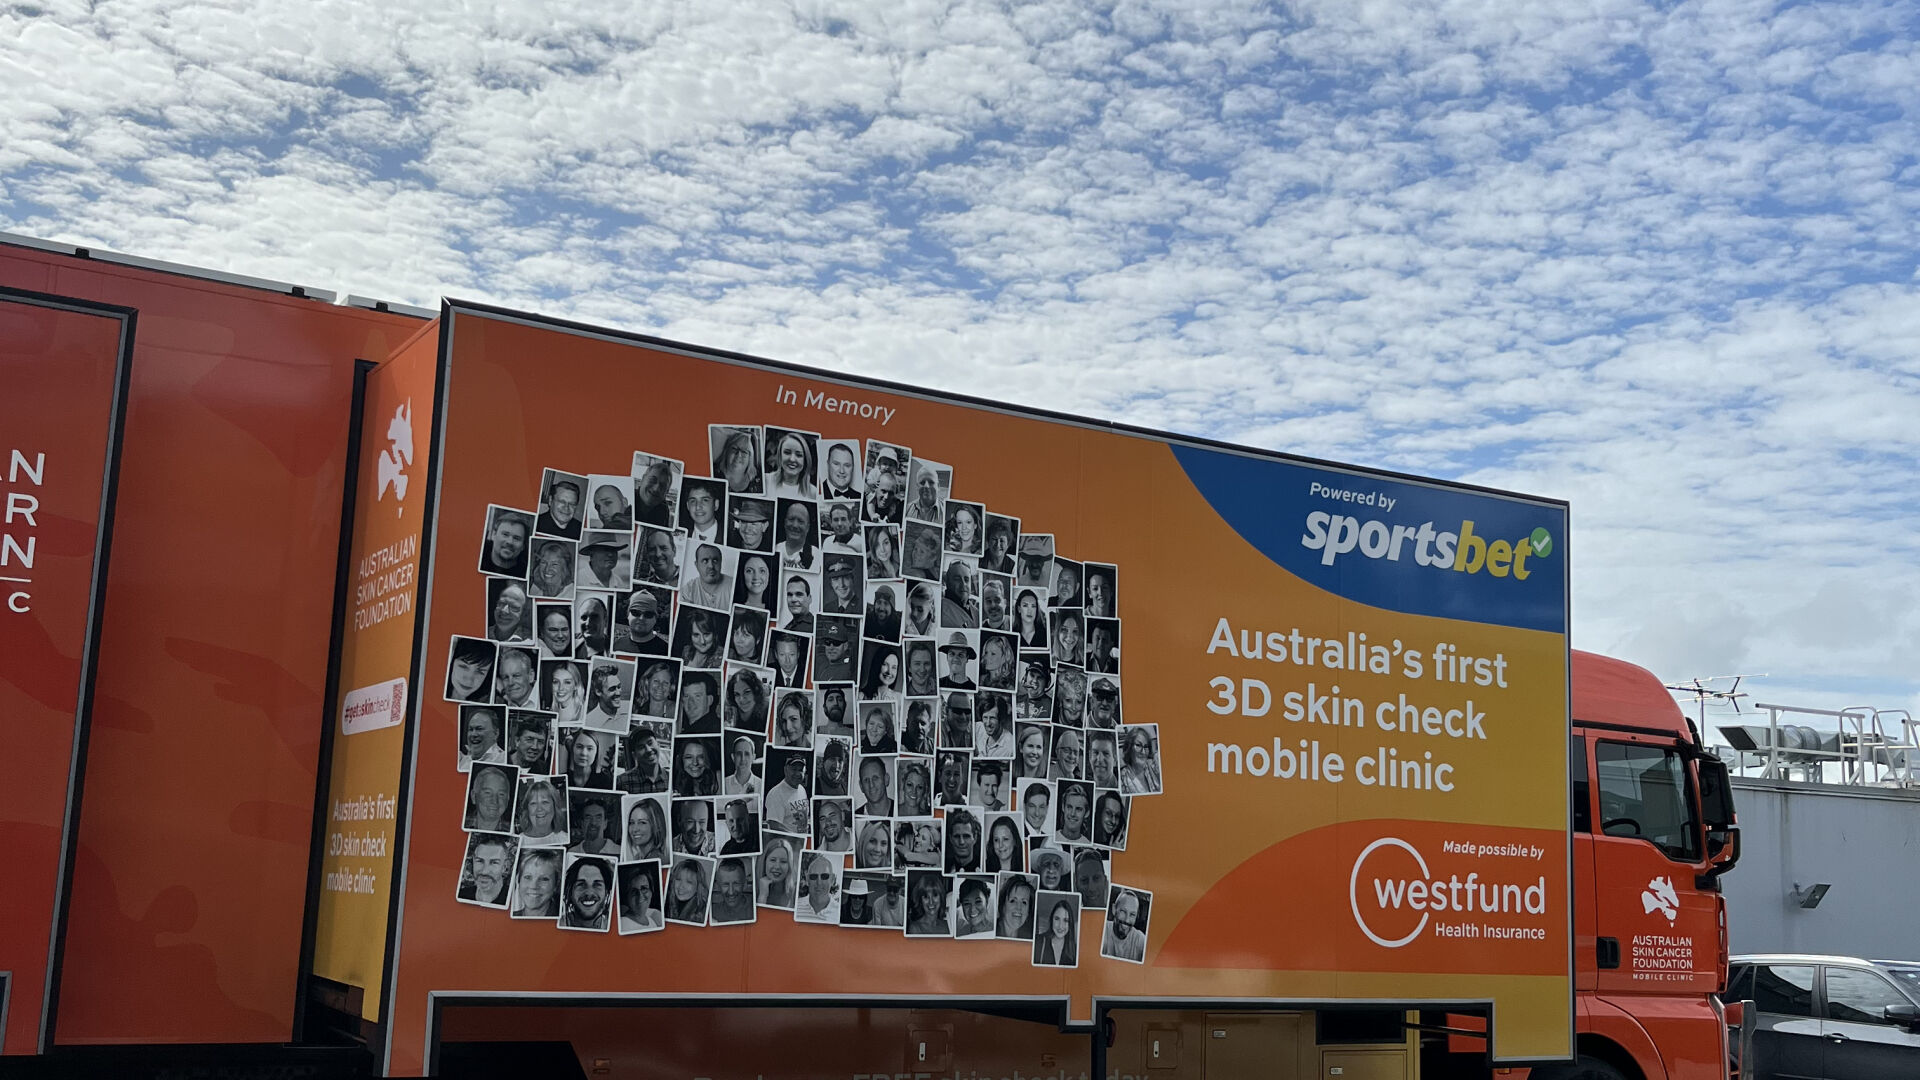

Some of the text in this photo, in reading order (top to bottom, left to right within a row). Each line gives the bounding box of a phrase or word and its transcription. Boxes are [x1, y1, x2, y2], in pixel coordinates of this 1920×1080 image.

[776, 385, 896, 425] In Memory
[1310, 482, 1396, 512] Powered by
[359, 533, 417, 580] AUSTRALIAN
[1301, 511, 1533, 581] sportsbet
[356, 562, 414, 606] SKIN CANCER
[354, 590, 412, 633] FOUNDATION
[1206, 617, 1508, 689] Australia's first
[1206, 676, 1487, 740] 3D skin check
[1207, 737, 1455, 792] mobile clinic
[333, 793, 395, 821] Australia's first
[330, 830, 387, 857] 3D skin check
[1443, 840, 1544, 861] Made possible by
[327, 866, 376, 895] mobile clinic
[1373, 872, 1545, 915] westfund
[1435, 921, 1545, 940] Health Insurance
[1632, 935, 1692, 947] AUSTRALIAN
[1632, 946, 1692, 958] SKIN CANCER
[1633, 958, 1693, 969] FOUNDATION
[1632, 973, 1663, 981] MOBILE
